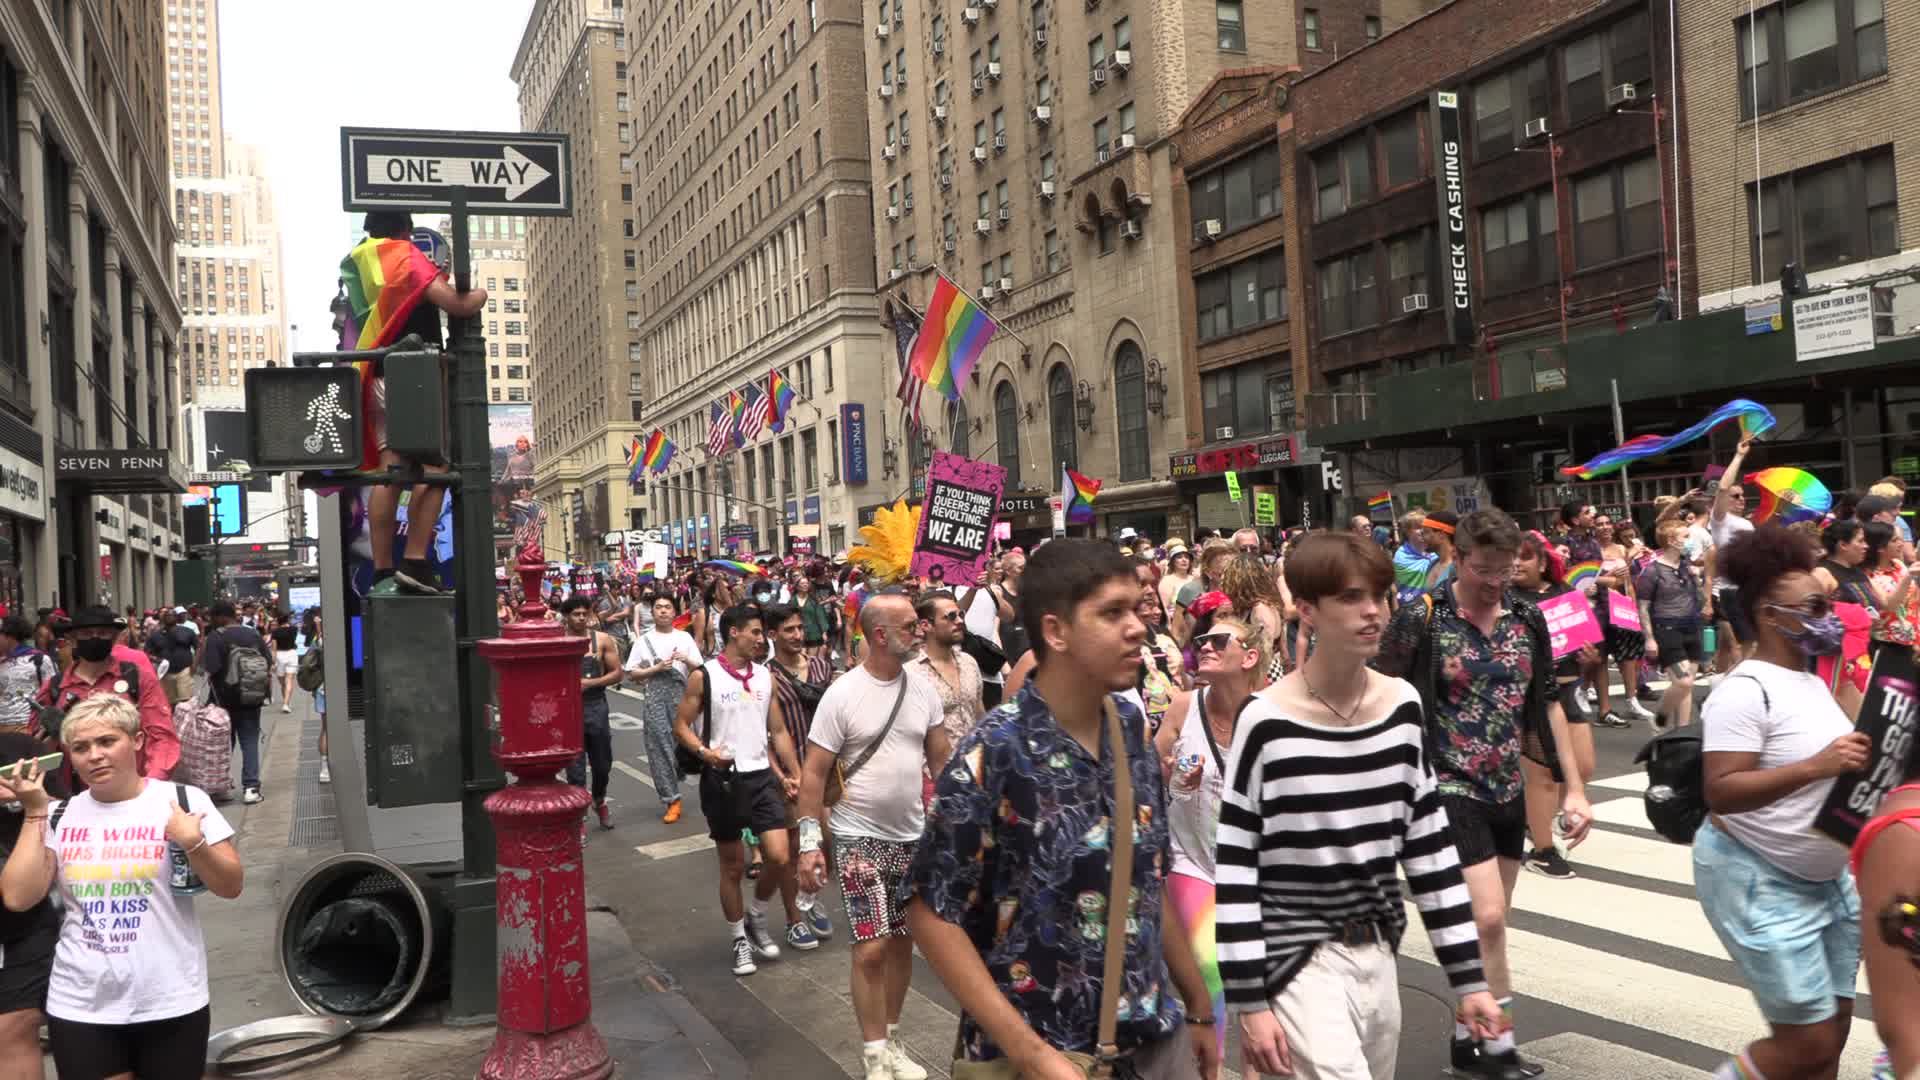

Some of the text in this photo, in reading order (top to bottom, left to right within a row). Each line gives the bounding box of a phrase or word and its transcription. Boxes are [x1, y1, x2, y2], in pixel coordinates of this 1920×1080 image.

[386, 158, 530, 185] ONE WAY
[1444, 141, 1469, 309] CHECK CASHING
[852, 422, 862, 446] PNC
[59, 457, 164, 470] SEVEN PENN
[1260, 451, 1290, 464] LUGGAGE
[936, 485, 993, 507] IF YOU THINK
[934, 495, 991, 517] QUEERS ARE
[999, 500, 1036, 511] HOTEL
[928, 520, 986, 550] WE ARE
[61, 827, 92, 842] THE
[63, 845, 165, 863] HAS BIGGER
[111, 882, 153, 896] BOYS
[111, 900, 149, 914] KISS
[112, 916, 141, 929] AND
[110, 931, 137, 943] WHO
